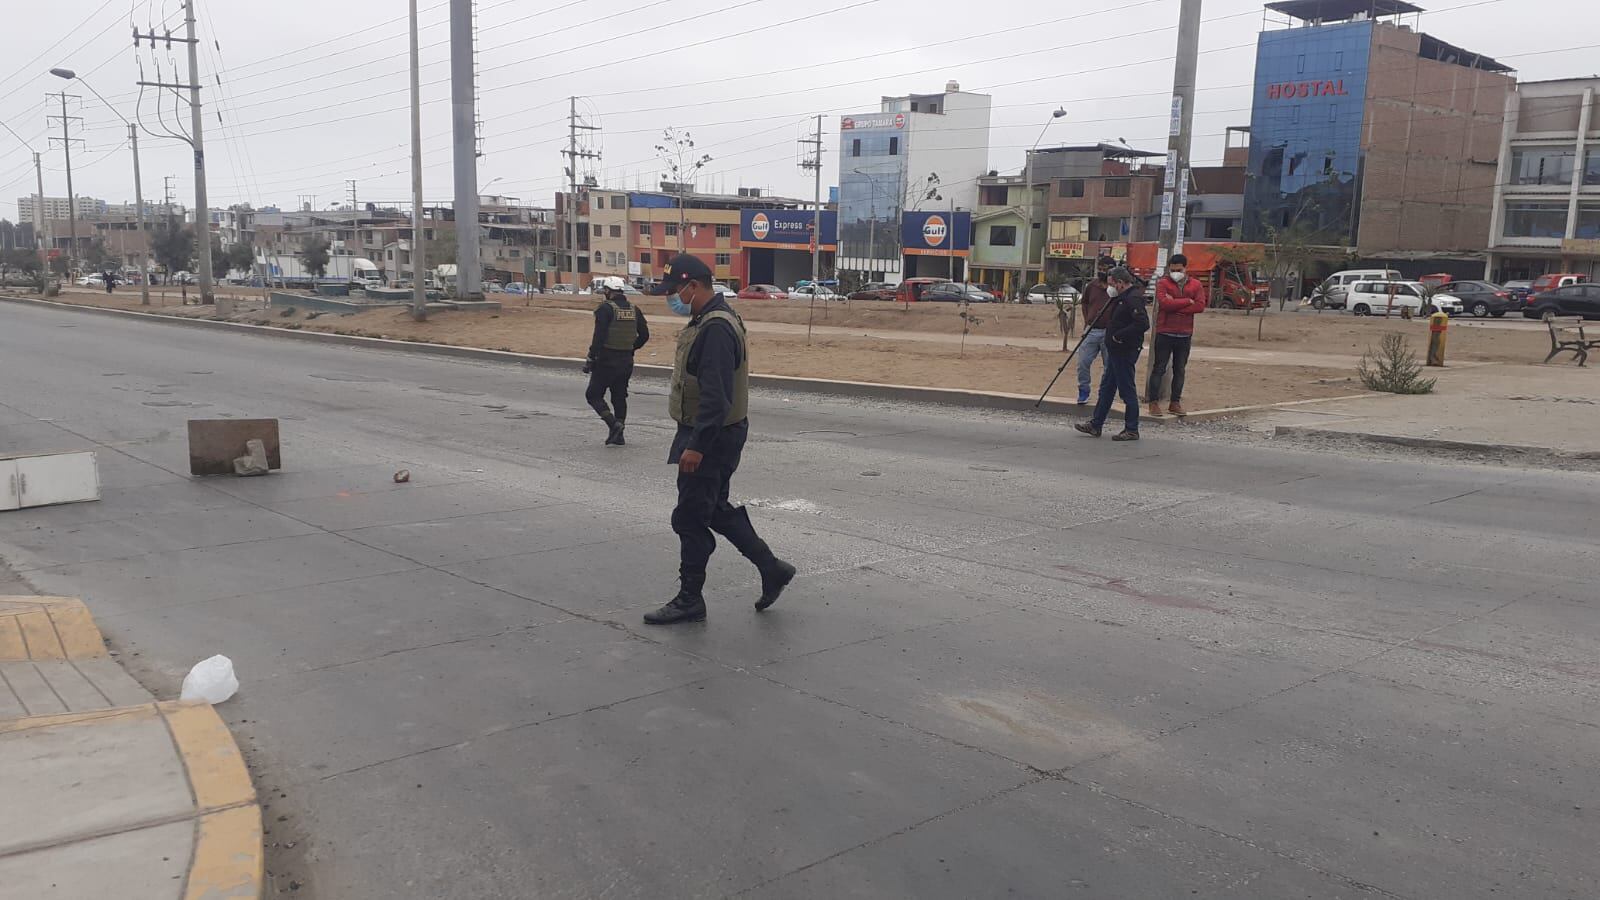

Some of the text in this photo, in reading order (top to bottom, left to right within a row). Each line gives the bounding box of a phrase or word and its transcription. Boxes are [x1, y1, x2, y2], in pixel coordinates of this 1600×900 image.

[1267, 80, 1348, 99] HOSTAL
[855, 120, 871, 129] GRUPO
[752, 222, 768, 230] Gulf
[774, 220, 802, 230] Express
[924, 226, 945, 235] Gulf
